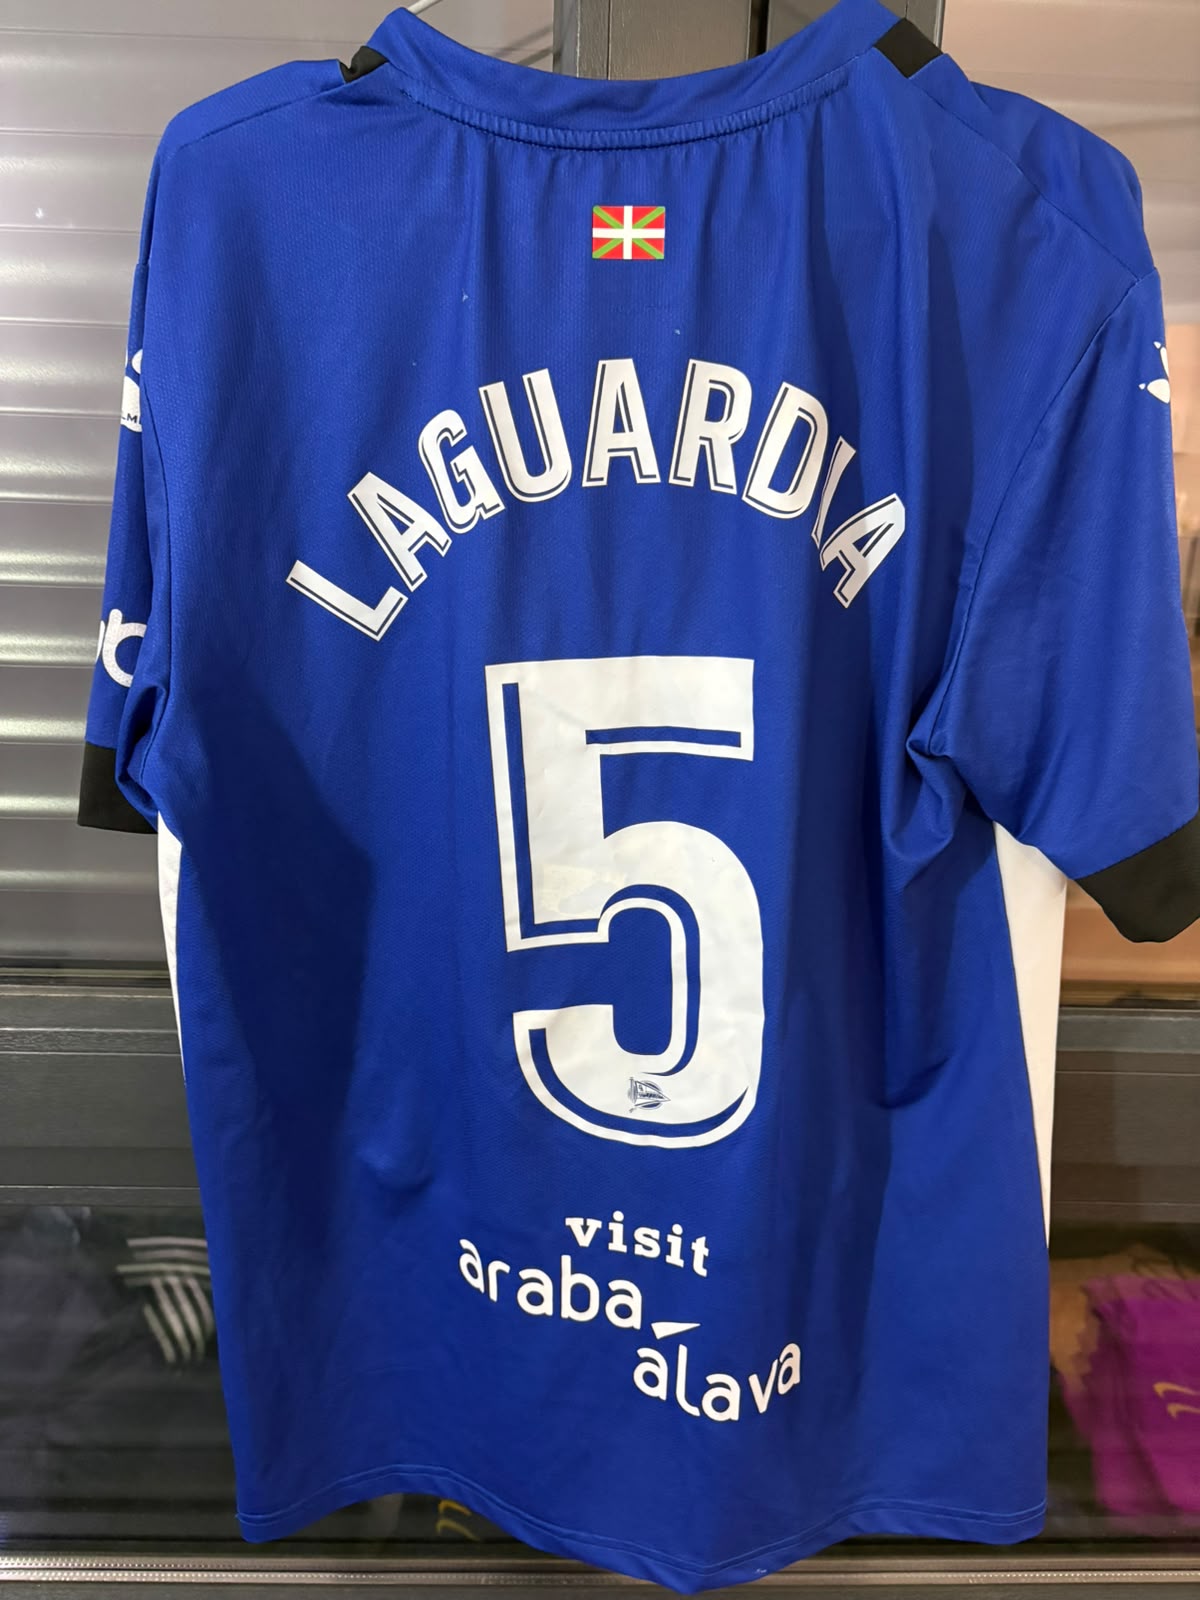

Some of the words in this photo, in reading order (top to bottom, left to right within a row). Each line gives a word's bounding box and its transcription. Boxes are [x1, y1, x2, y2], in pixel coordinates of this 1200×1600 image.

[285, 357, 907, 642] LAGUARDIA
[484, 655, 766, 1149] 5
[459, 1238, 643, 1330] araba
[565, 1210, 710, 1277] visit
